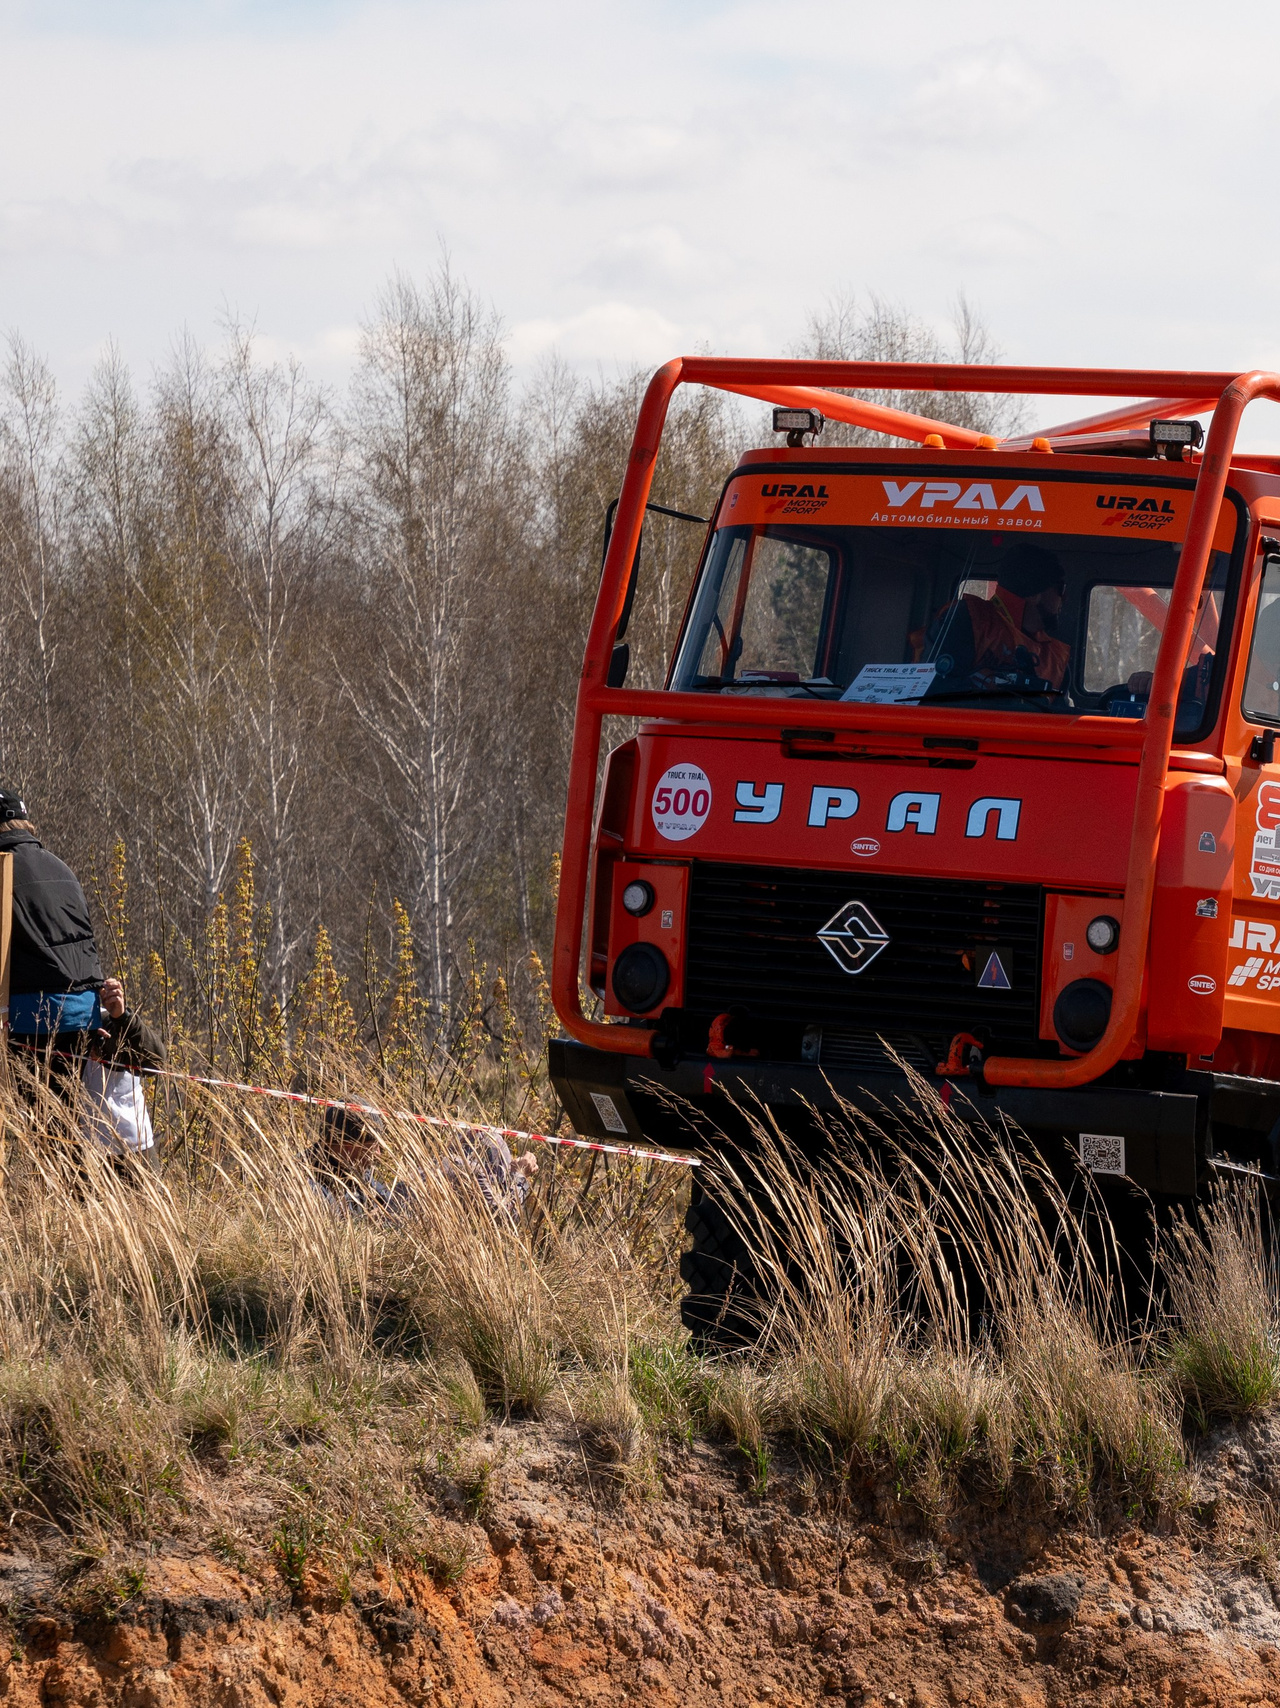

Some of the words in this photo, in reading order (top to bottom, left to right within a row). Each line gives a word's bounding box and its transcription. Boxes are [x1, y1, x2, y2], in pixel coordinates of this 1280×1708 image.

[760, 484, 830, 499] URAL
[881, 480, 1046, 512] УРАЛ
[787, 499, 828, 508] MOTOR
[1095, 494, 1176, 514] URAL
[781, 506, 821, 515] SPORT
[870, 511, 989, 525] Автомобильный
[996, 517, 1043, 528] завод
[1127, 513, 1174, 523] MOTOR
[1121, 520, 1166, 530] SPORT
[667, 771, 686, 780] TRUCK
[688, 772, 706, 781] TRIAL
[654, 787, 710, 817] 500
[733, 780, 1022, 841] УРАЛ
[1256, 834, 1274, 845] лет
[852, 842, 879, 851] SINTEC
[1258, 864, 1266, 872] СО
[1189, 980, 1215, 990] SINTEC
